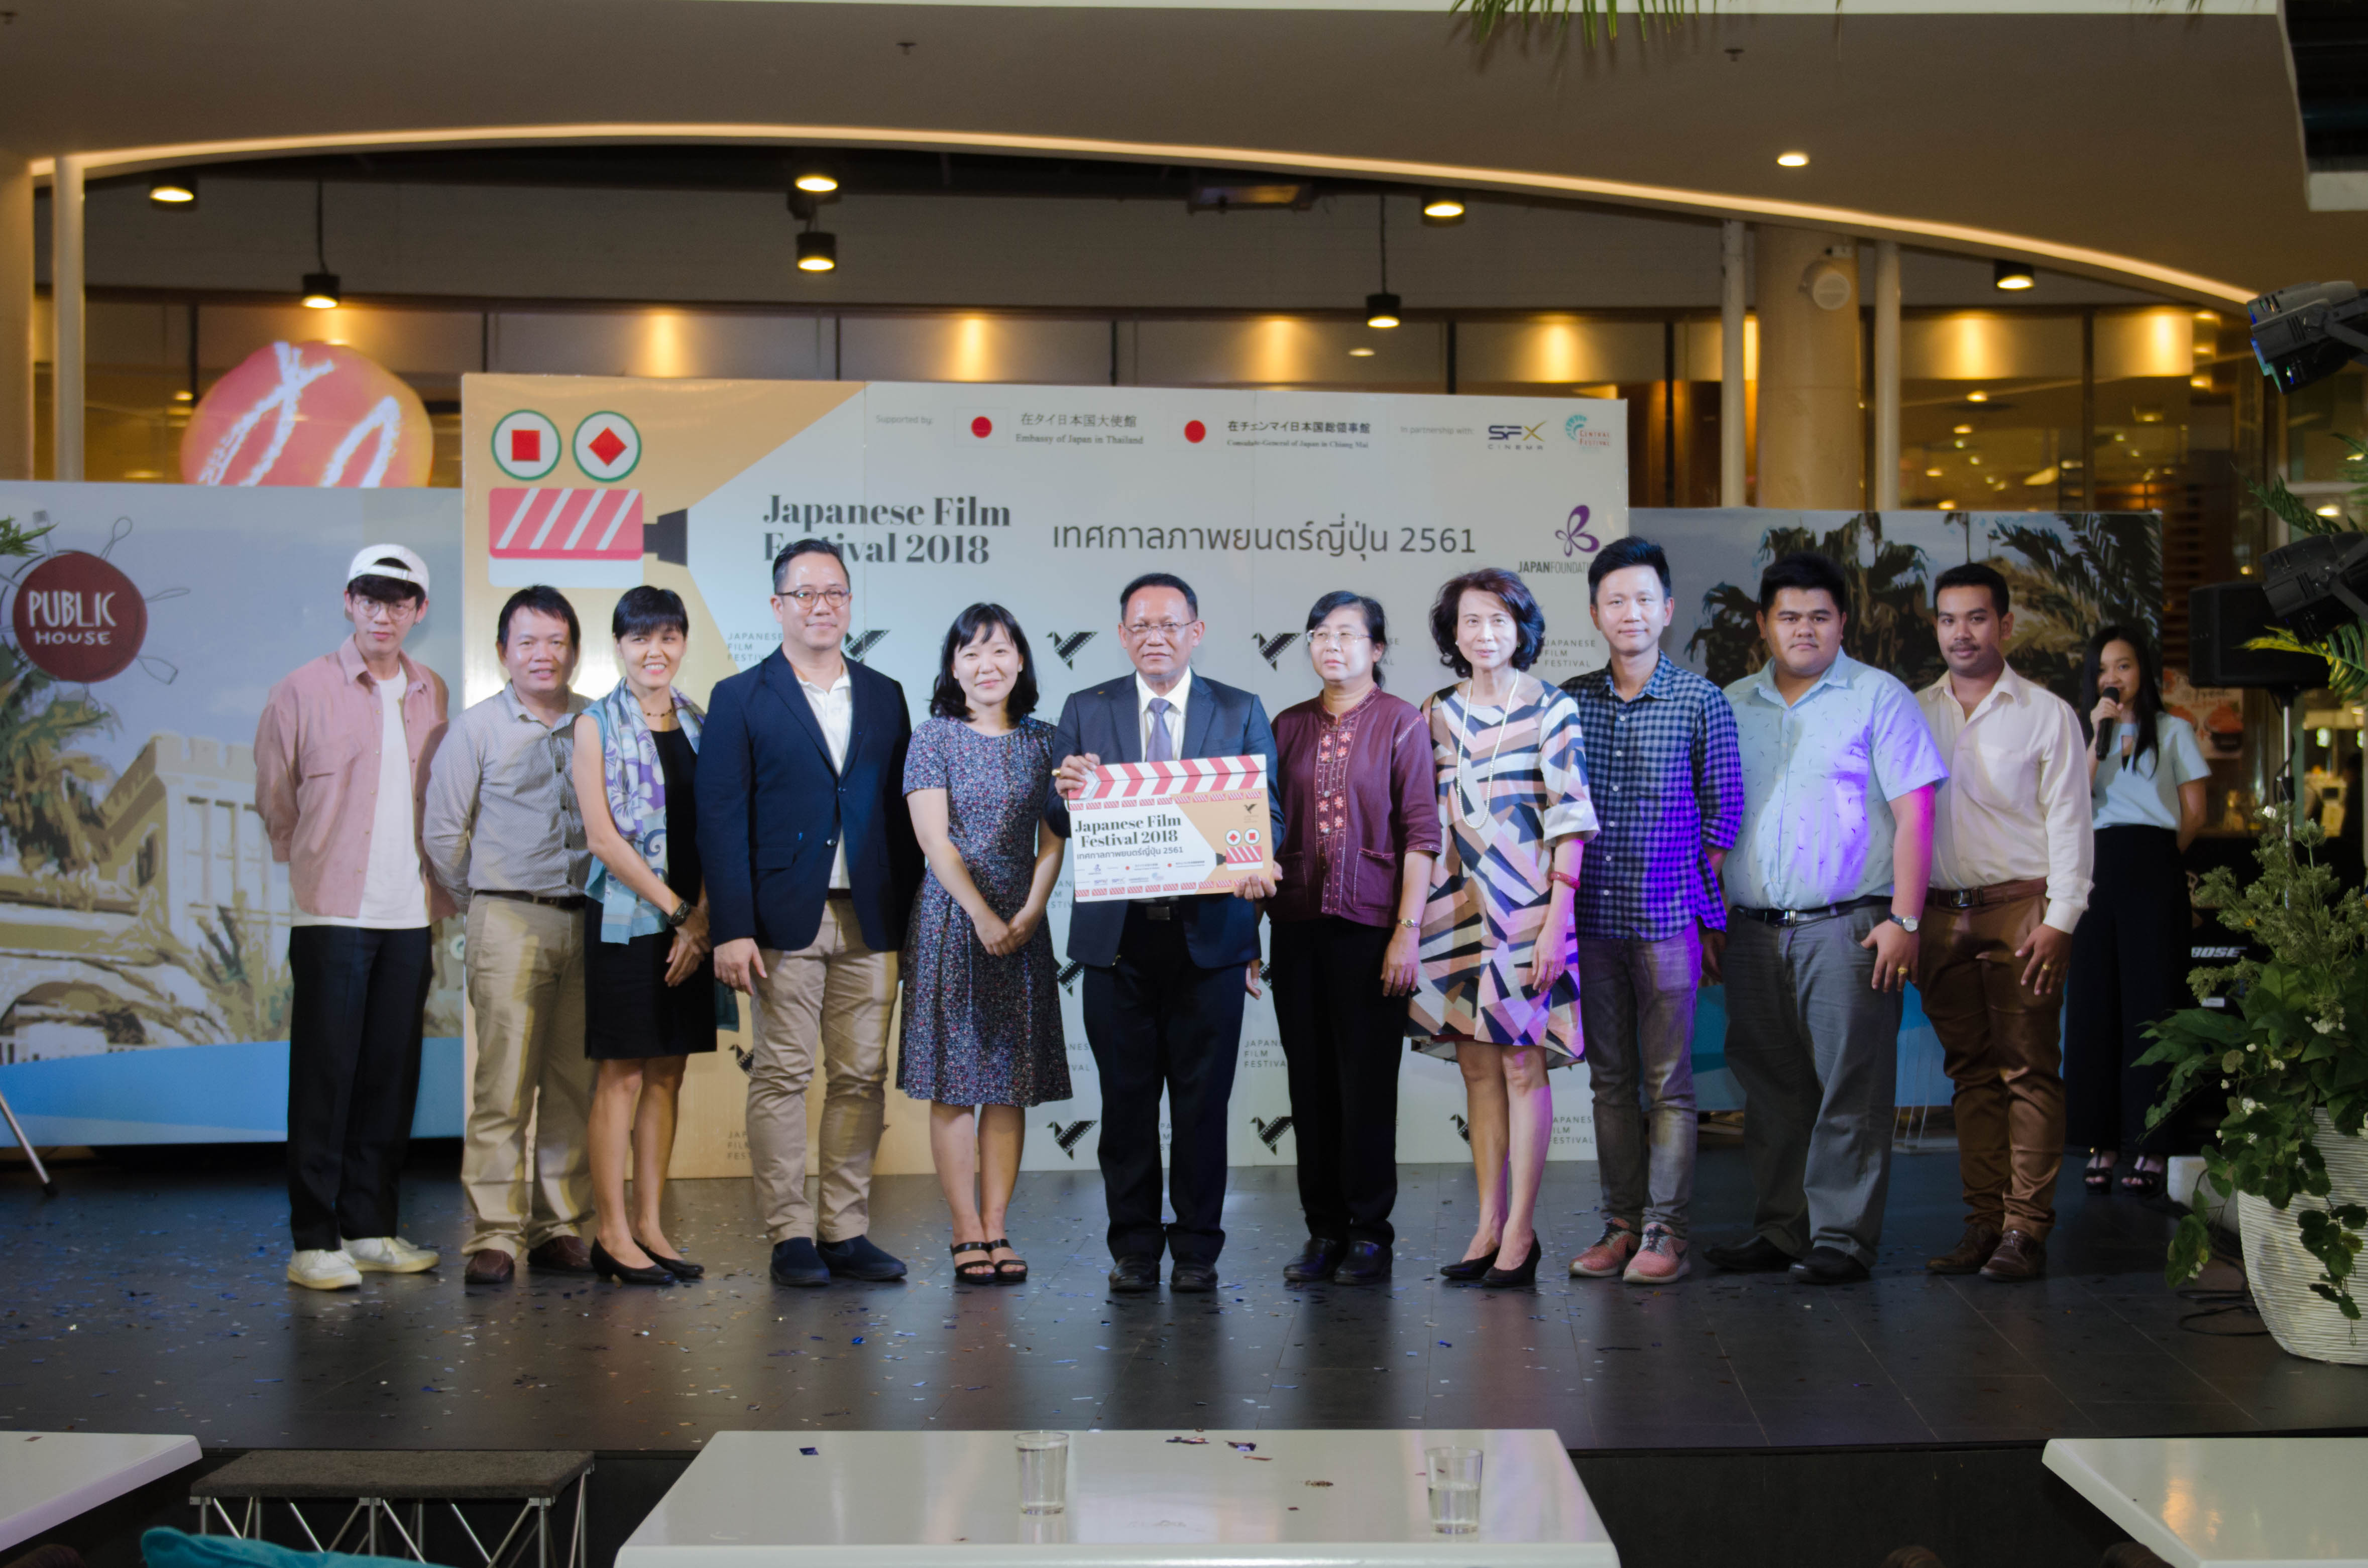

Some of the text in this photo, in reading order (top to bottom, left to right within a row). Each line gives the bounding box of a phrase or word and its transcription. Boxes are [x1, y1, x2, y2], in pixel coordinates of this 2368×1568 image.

[876, 414, 918, 425] Supported
[1021, 413, 1138, 427] 在タイ日本国大使館
[1228, 421, 1371, 434] 在チェンマイ日本国総領事館
[1410, 426, 1454, 435] partnership
[1488, 421, 1547, 442] SFX
[1016, 434, 1144, 445] Embassy of Japan in Thailand
[1299, 440, 1319, 449] Japan
[1329, 440, 1353, 449] Chiang
[763, 495, 1011, 533] Japanese Film
[1054, 513, 1476, 562] เทศกาลภาพยนตร์ญี่ปุ่น 2561
[764, 532, 989, 564] Fival 2018
[1518, 561, 1590, 574] JAPANFOUNDATI
[28, 590, 117, 627] PUBLIC
[35, 631, 111, 646] HOUSE
[1545, 639, 1595, 647] JAPANESE
[728, 643, 752, 651] FILM
[1545, 659, 1591, 667] FESTIVAL
[1075, 814, 1182, 835] Japanese Film
[1080, 829, 1178, 848] Festival 2018
[1077, 845, 1161, 860] เทศกาลภาพยนตร์ญี่ปุ่น
[2191, 946, 2247, 957] BOSE
[1244, 1040, 1283, 1048] JAPAN
[1244, 1060, 1286, 1068] FESTIVA
